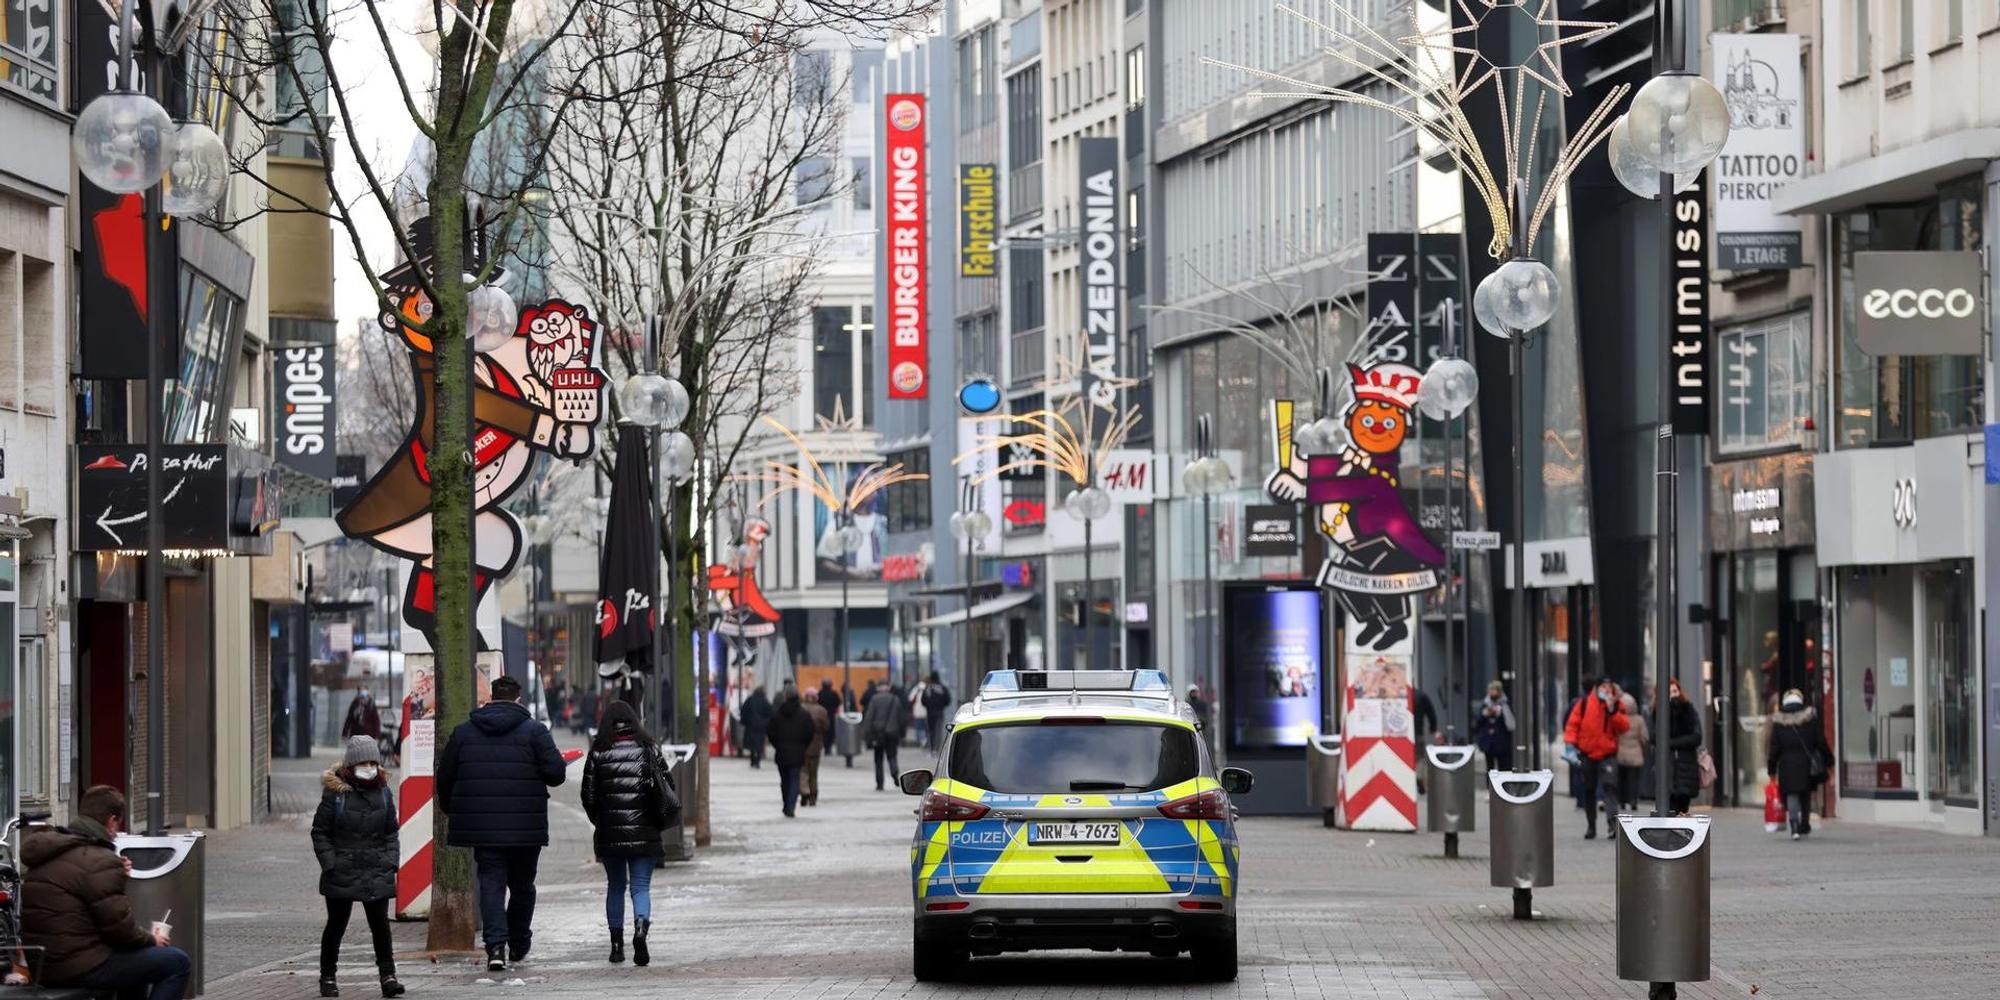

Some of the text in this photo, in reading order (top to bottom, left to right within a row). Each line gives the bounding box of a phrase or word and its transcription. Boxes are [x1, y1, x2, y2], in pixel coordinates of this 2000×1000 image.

[1719, 154, 1799, 177] TATTOO
[892, 147, 919, 221] KING
[1719, 182, 1786, 200] PIERCI
[961, 166, 995, 275] Fahrschule
[1734, 247, 1788, 264] 1.ETAGE
[892, 227, 920, 347] BURGER
[1086, 169, 1117, 408] CALZEDONIA
[1671, 182, 1703, 405] intimiss
[1863, 288, 1975, 318] ecco
[557, 372, 595, 386] UHU
[284, 346, 333, 456] snipes
[129, 452, 223, 474] Piza Hut
[952, 831, 1007, 845] POLIZEI
[1036, 824, 1119, 840] NRW 4-7673
